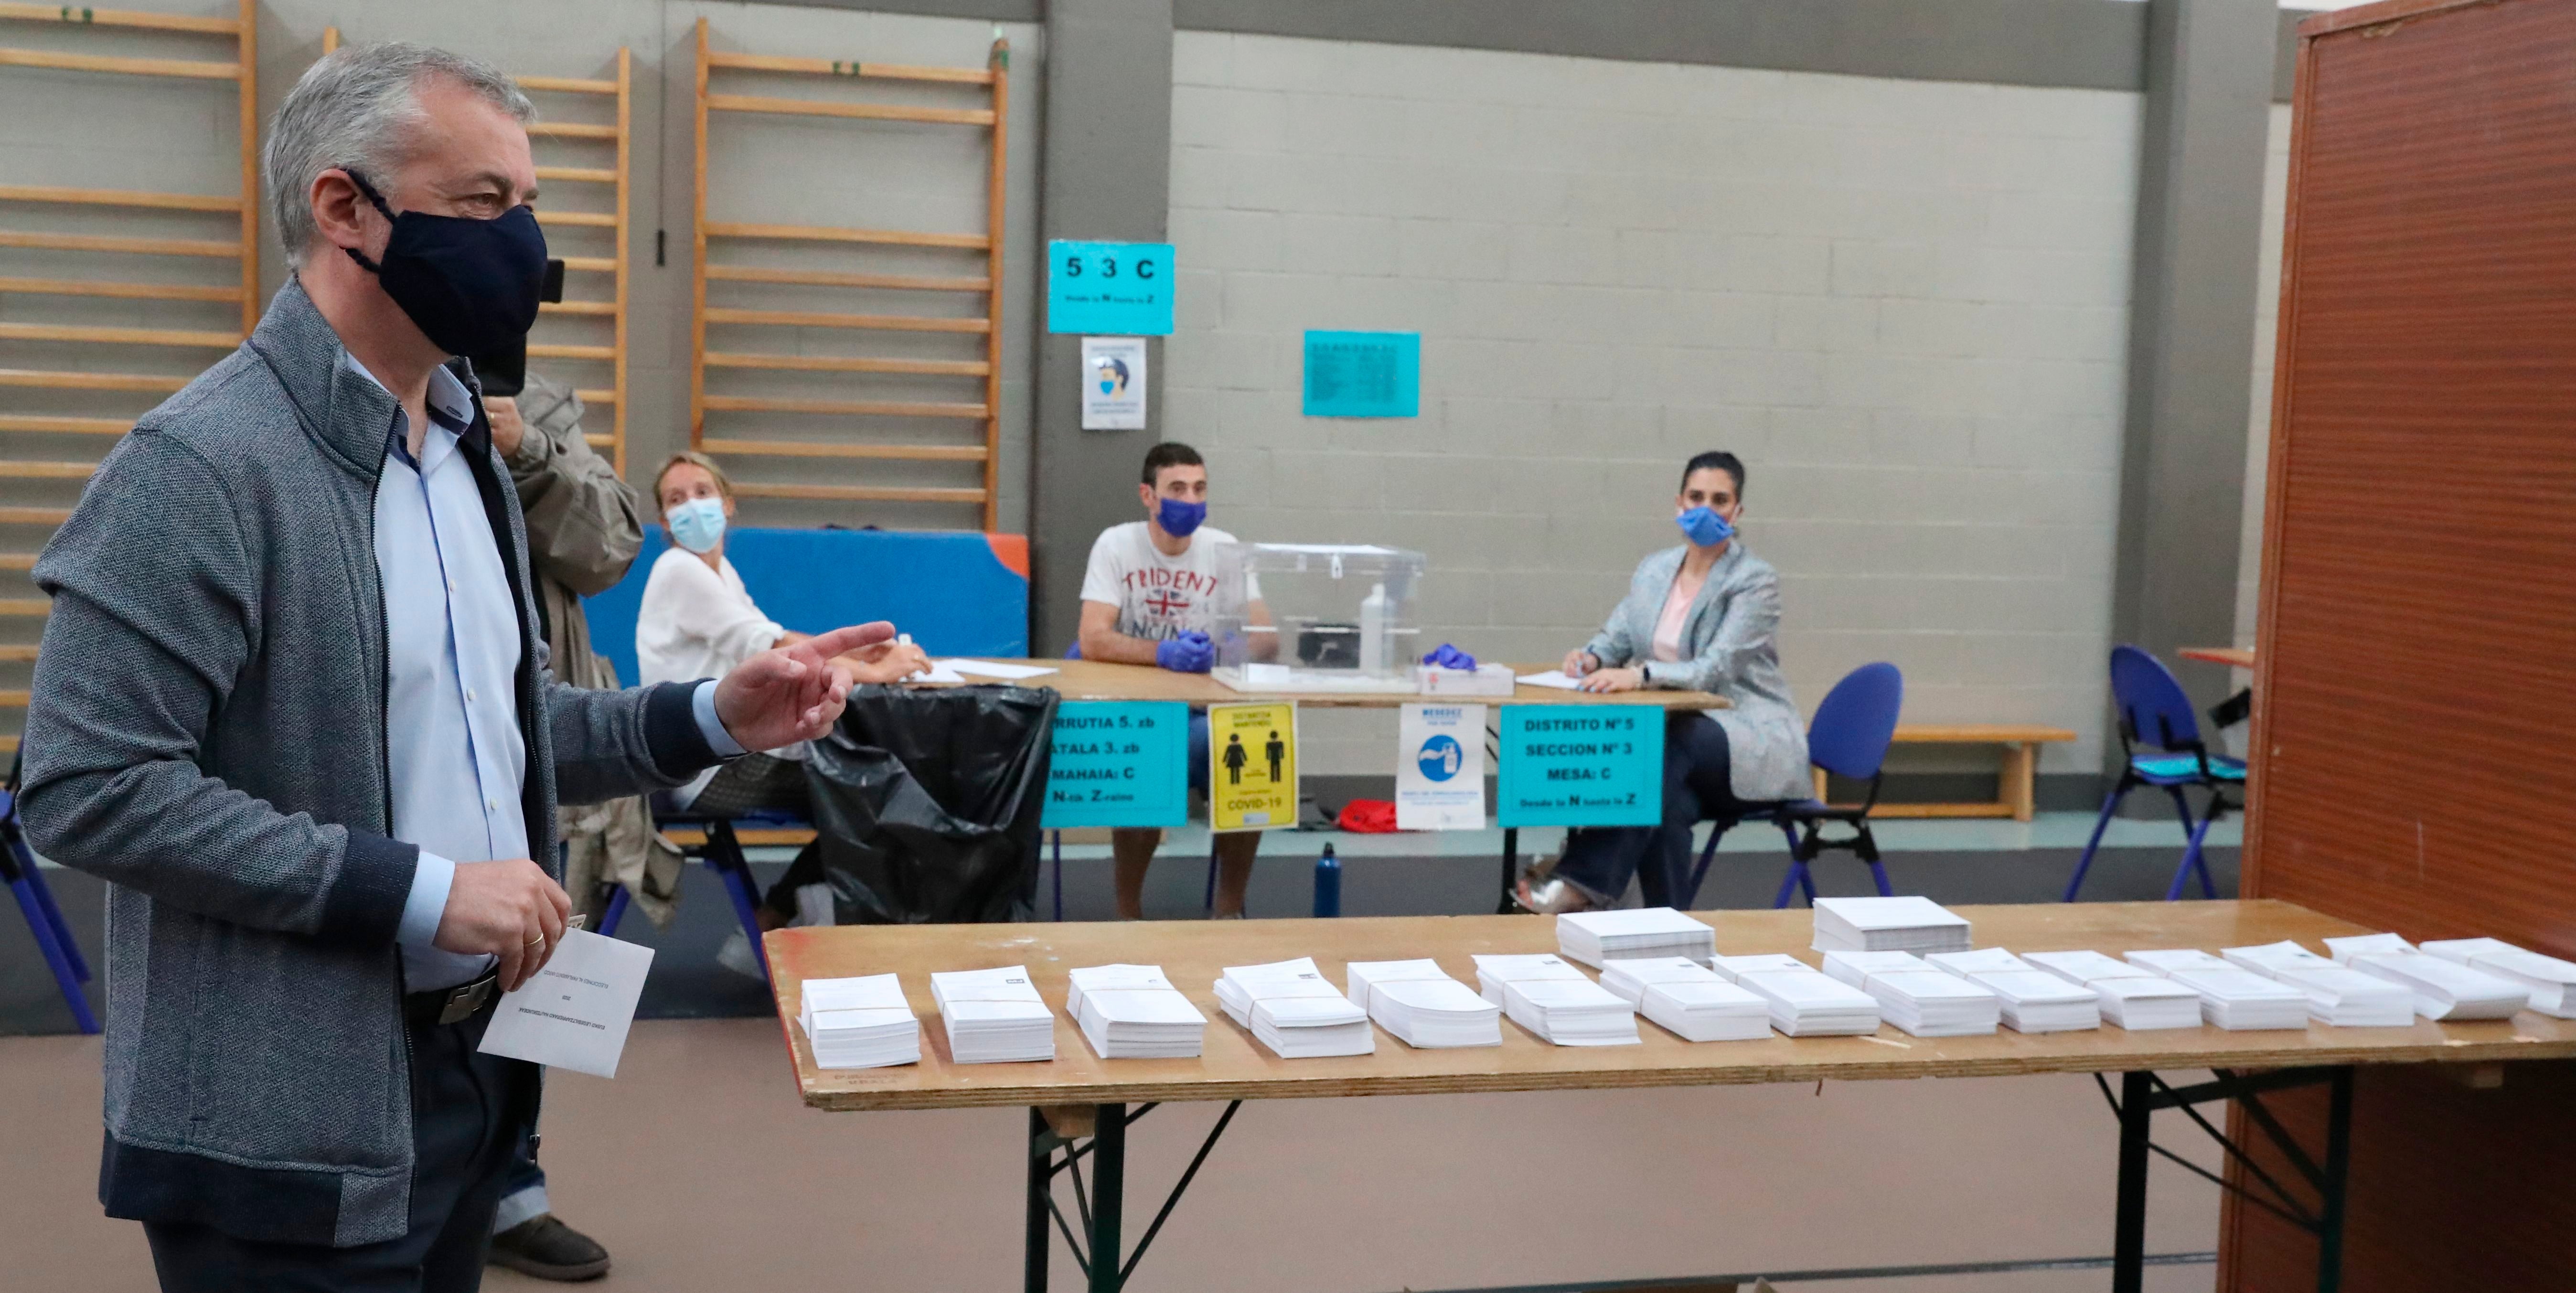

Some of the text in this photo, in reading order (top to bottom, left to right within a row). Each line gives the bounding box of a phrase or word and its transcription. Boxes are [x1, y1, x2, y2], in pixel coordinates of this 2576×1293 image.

[1067, 257, 1154, 279] 5 3 C
[1053, 717, 1114, 729] RRUTIA
[1525, 719, 1599, 732] DISTRITO
[1526, 743, 1596, 756] SECCION
[1624, 742, 1633, 755] 3
[1123, 767, 1134, 780] C
[1601, 767, 1611, 780] C
[1228, 797, 1282, 811] COVID-19
[1569, 794, 1580, 806] N
[1626, 792, 1636, 805] Z
